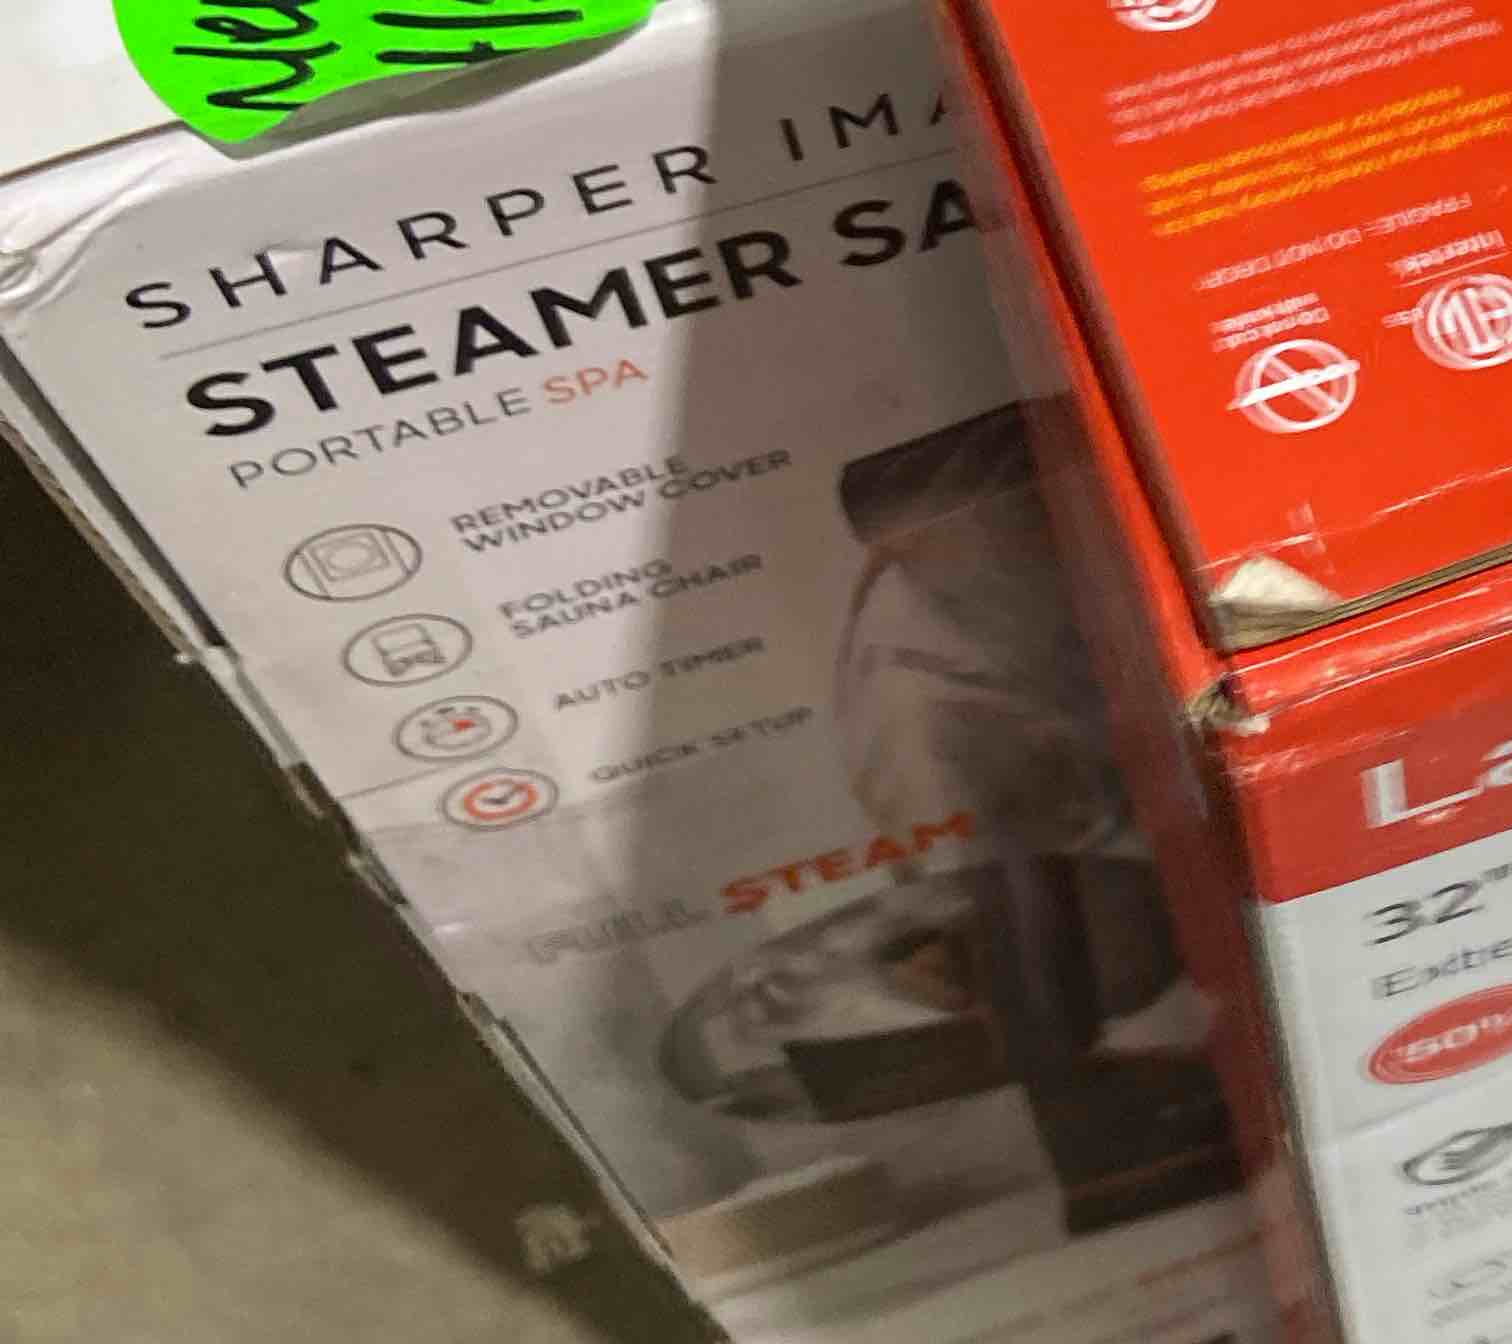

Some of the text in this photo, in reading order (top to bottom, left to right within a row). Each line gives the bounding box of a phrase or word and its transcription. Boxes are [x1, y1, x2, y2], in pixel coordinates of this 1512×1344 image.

[124, 142, 717, 331] SHARPER
[184, 229, 804, 440] STEAMER
[228, 357, 650, 493] PORTABLE SPA
[450, 455, 690, 536] REMOVABLE
[461, 449, 794, 556] WINDOW COVER
[499, 557, 675, 620] FOLDING
[508, 553, 766, 642] SAUNA CHAIR
[552, 667, 652, 714] AUTO
[719, 810, 979, 918] STEAM
